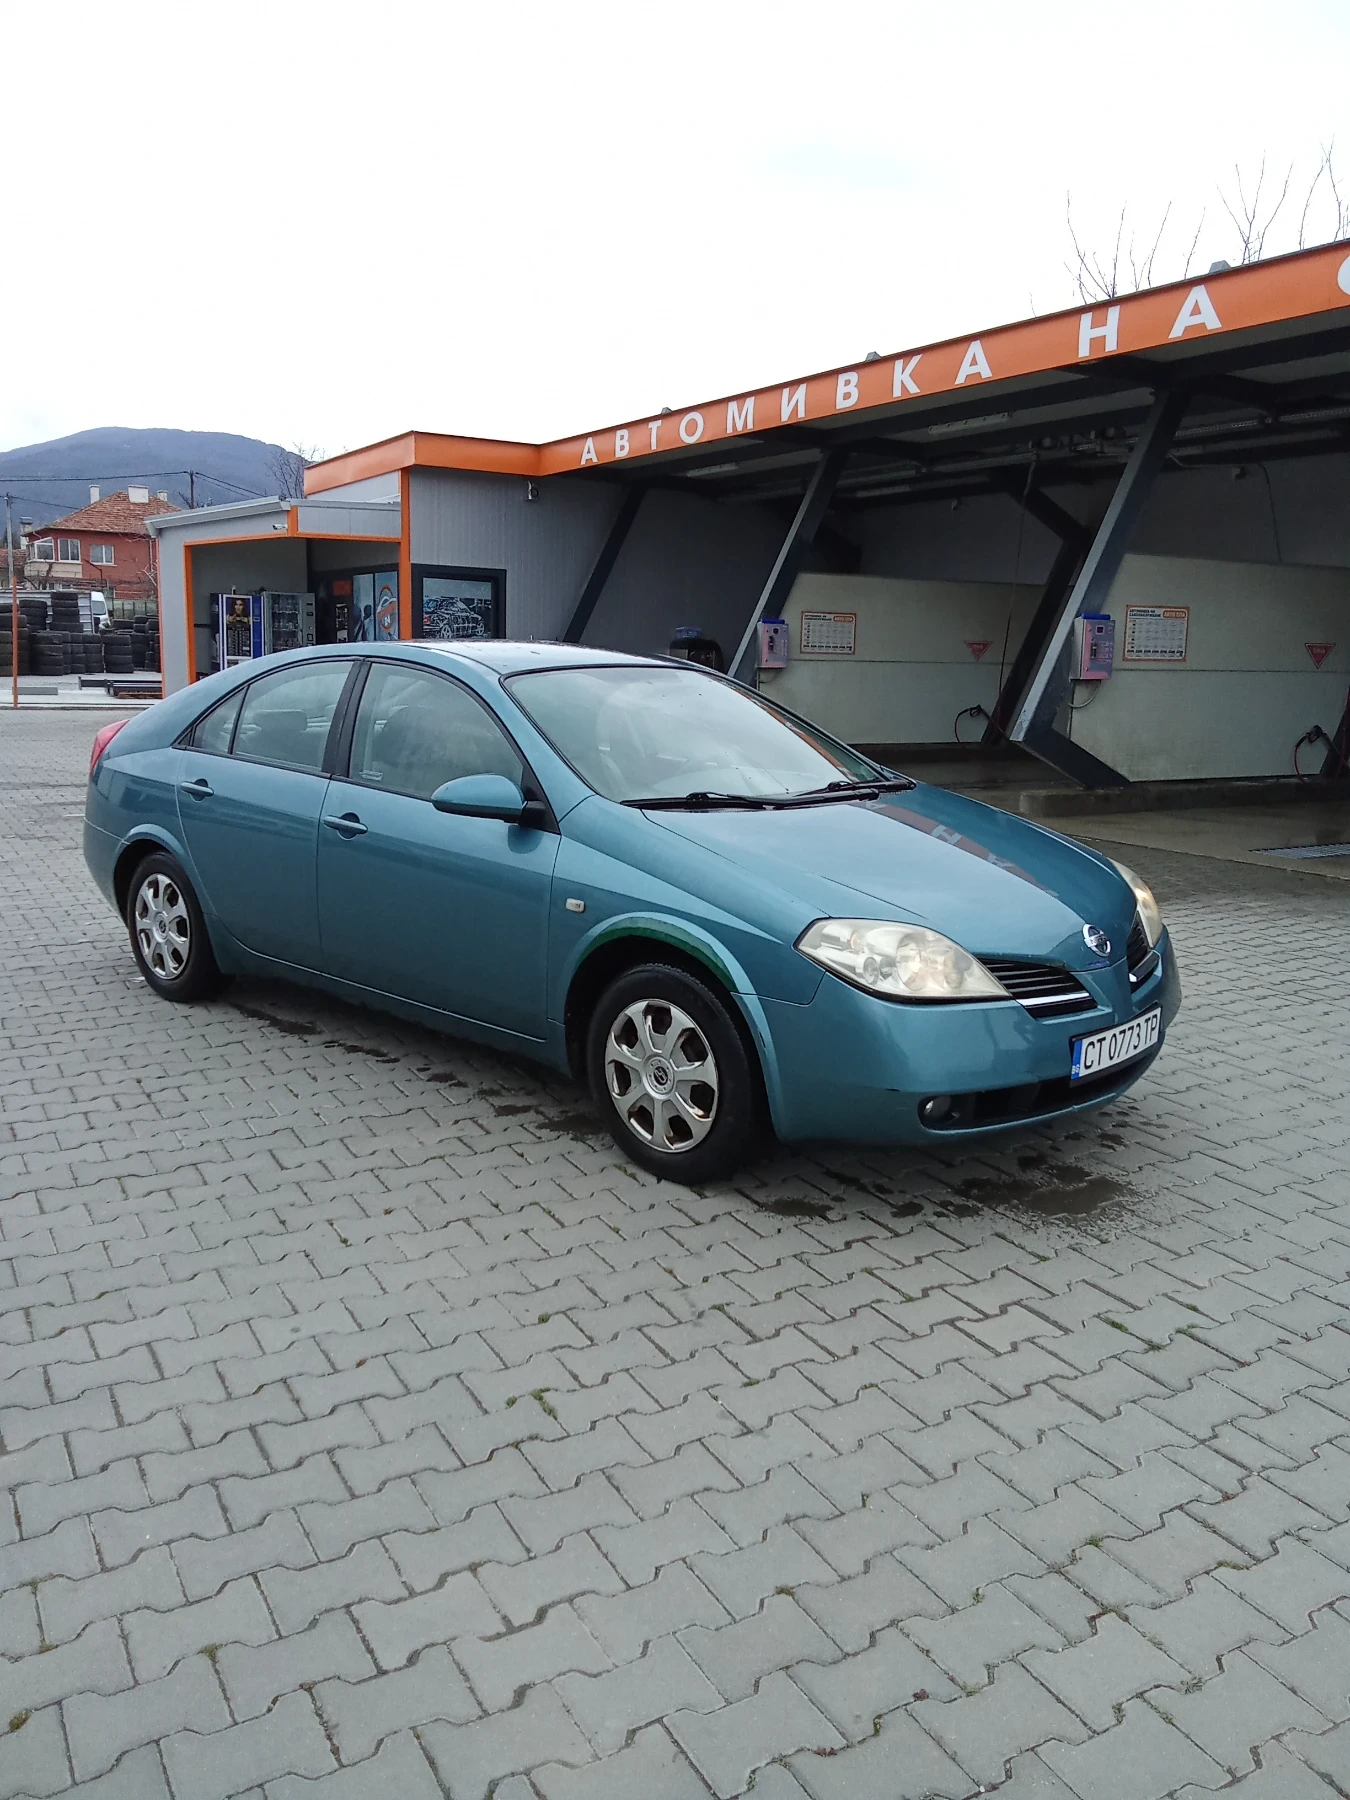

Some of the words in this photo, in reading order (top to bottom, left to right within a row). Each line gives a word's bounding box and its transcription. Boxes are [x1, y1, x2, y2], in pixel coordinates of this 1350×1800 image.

[580, 339, 993, 466] АВТОМИВКА
[1078, 284, 1223, 358] НА
[1084, 1037, 1106, 1069] CT
[1109, 1023, 1141, 1060] 0773
[1144, 1014, 1158, 1045] TP
